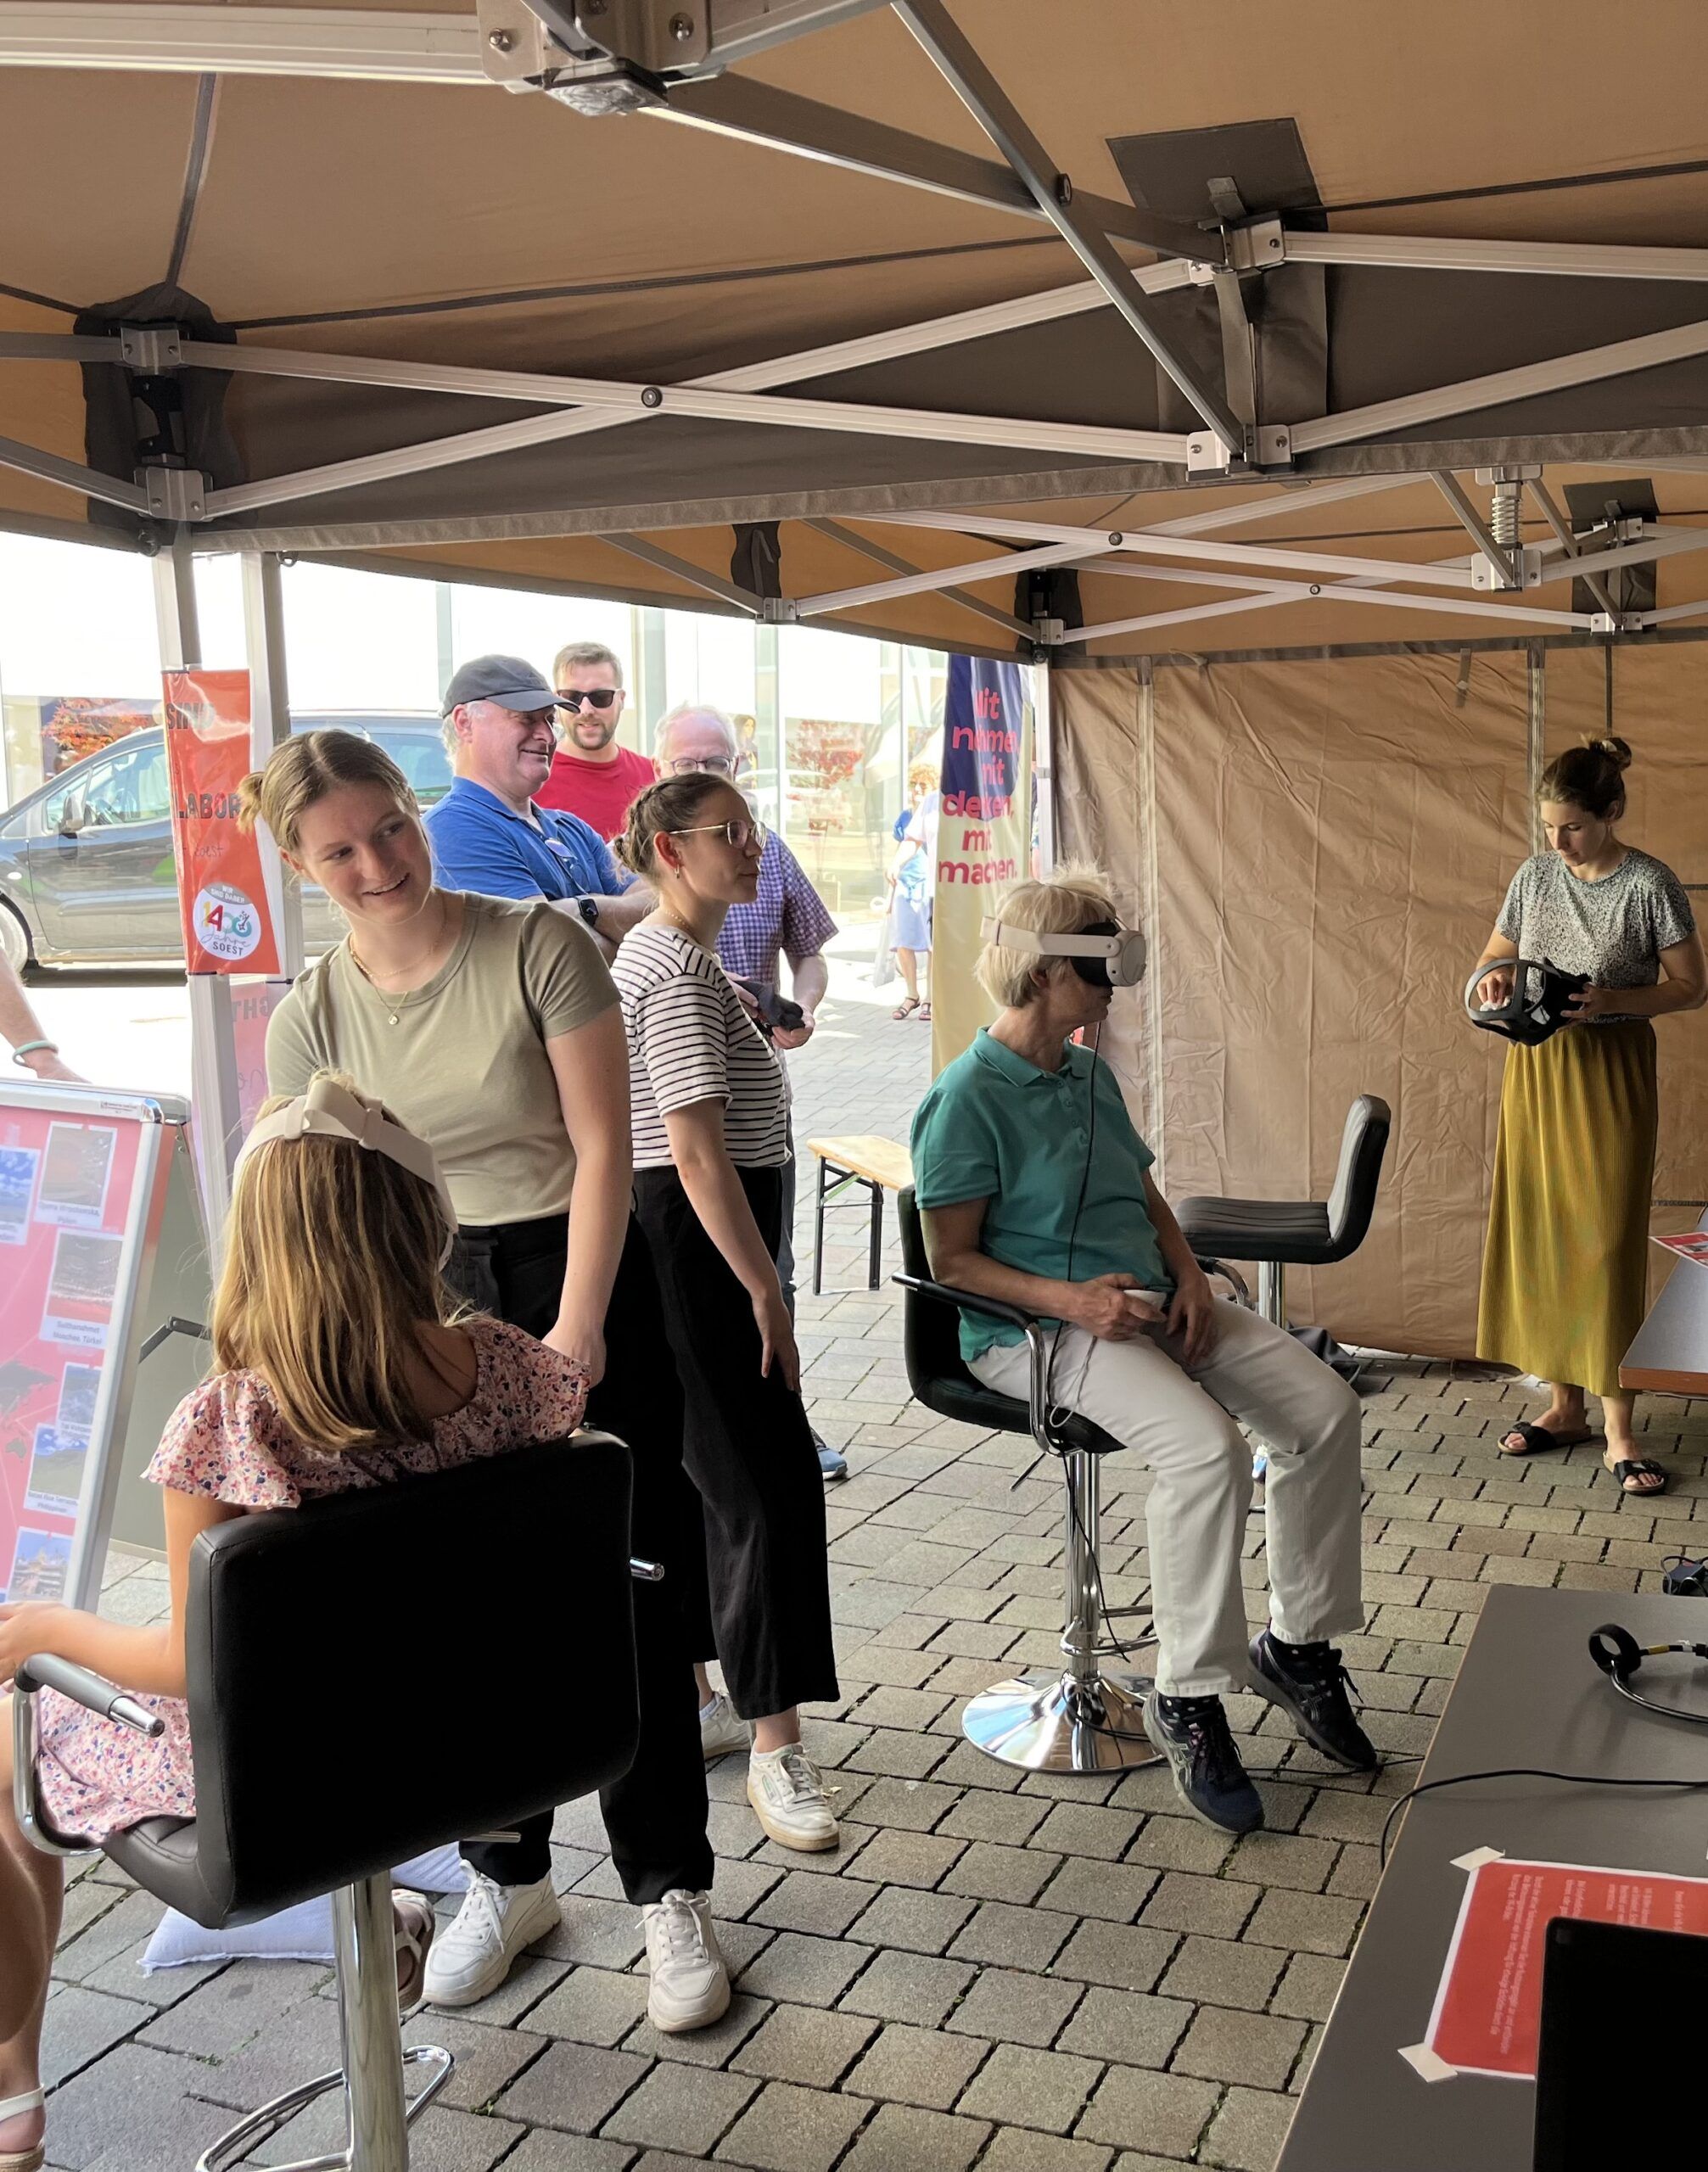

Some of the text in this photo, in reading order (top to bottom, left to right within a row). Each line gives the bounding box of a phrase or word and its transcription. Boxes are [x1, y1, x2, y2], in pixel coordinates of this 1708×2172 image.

[173, 792, 243, 819] LABOR
[938, 858, 1017, 885] machen.
[221, 885, 233, 894] WIR
[203, 900, 253, 938] 1400
[212, 941, 244, 956] SOEST
